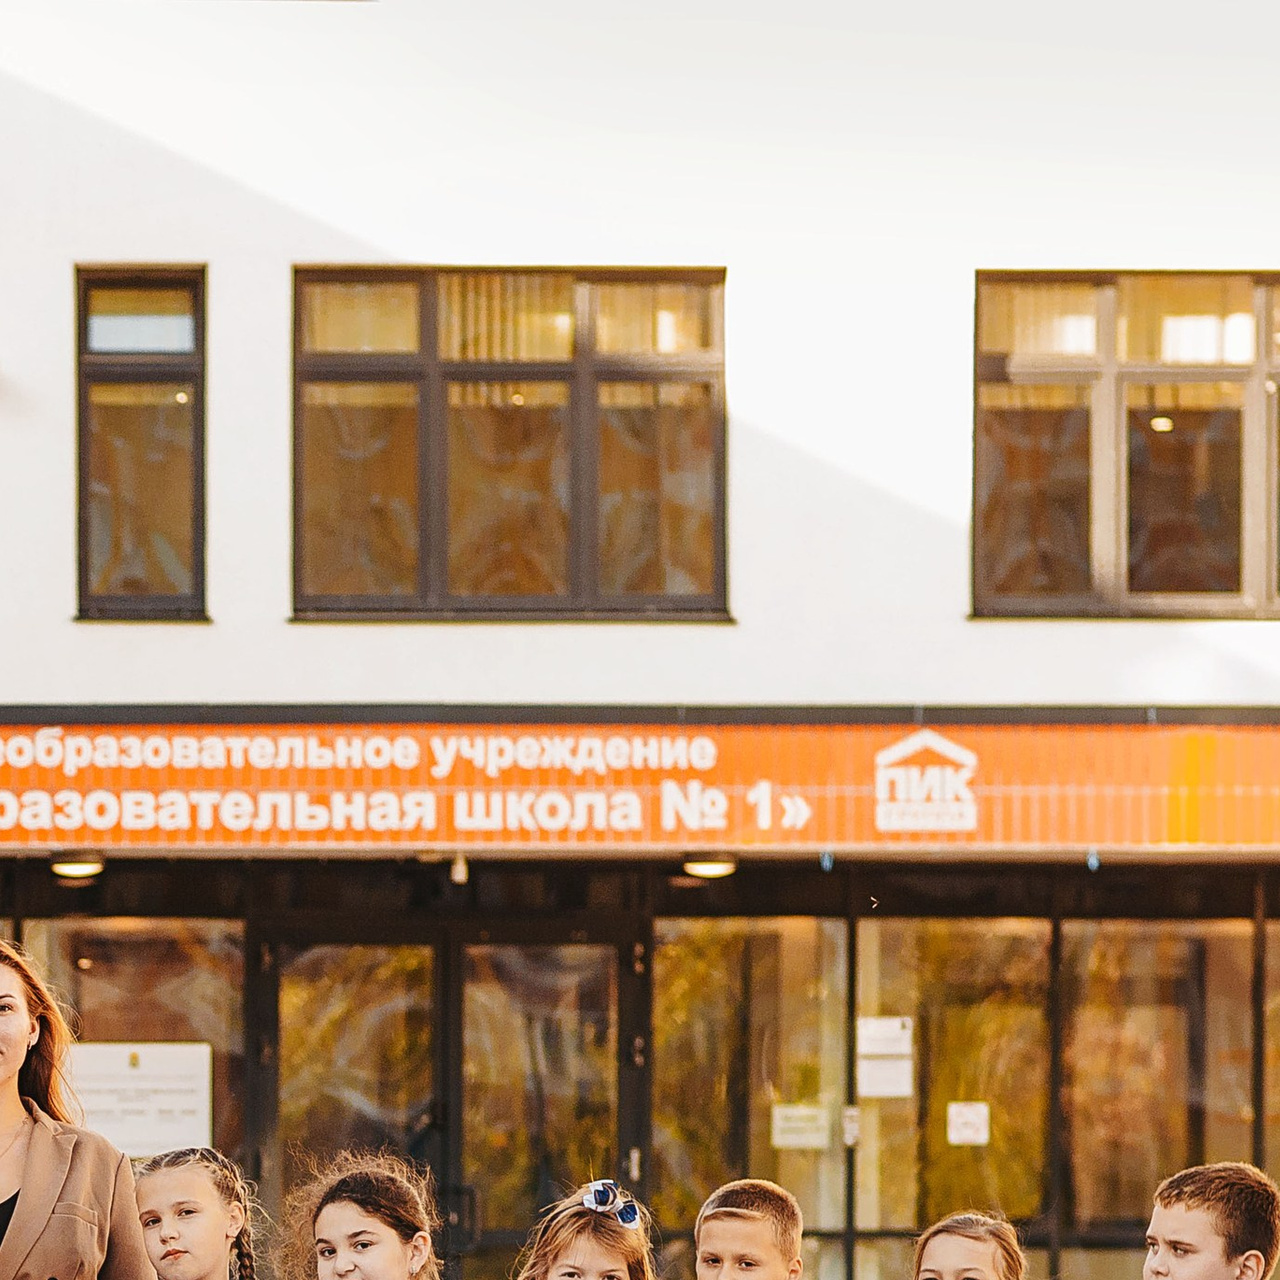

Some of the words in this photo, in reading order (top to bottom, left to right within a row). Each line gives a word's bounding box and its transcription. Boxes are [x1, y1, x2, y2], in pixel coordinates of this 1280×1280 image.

[431, 734, 716, 777] учреждение
[455, 788, 642, 832] школа
[661, 779, 727, 831] №
[747, 781, 813, 831] 1»
[875, 765, 976, 804] ПИК
